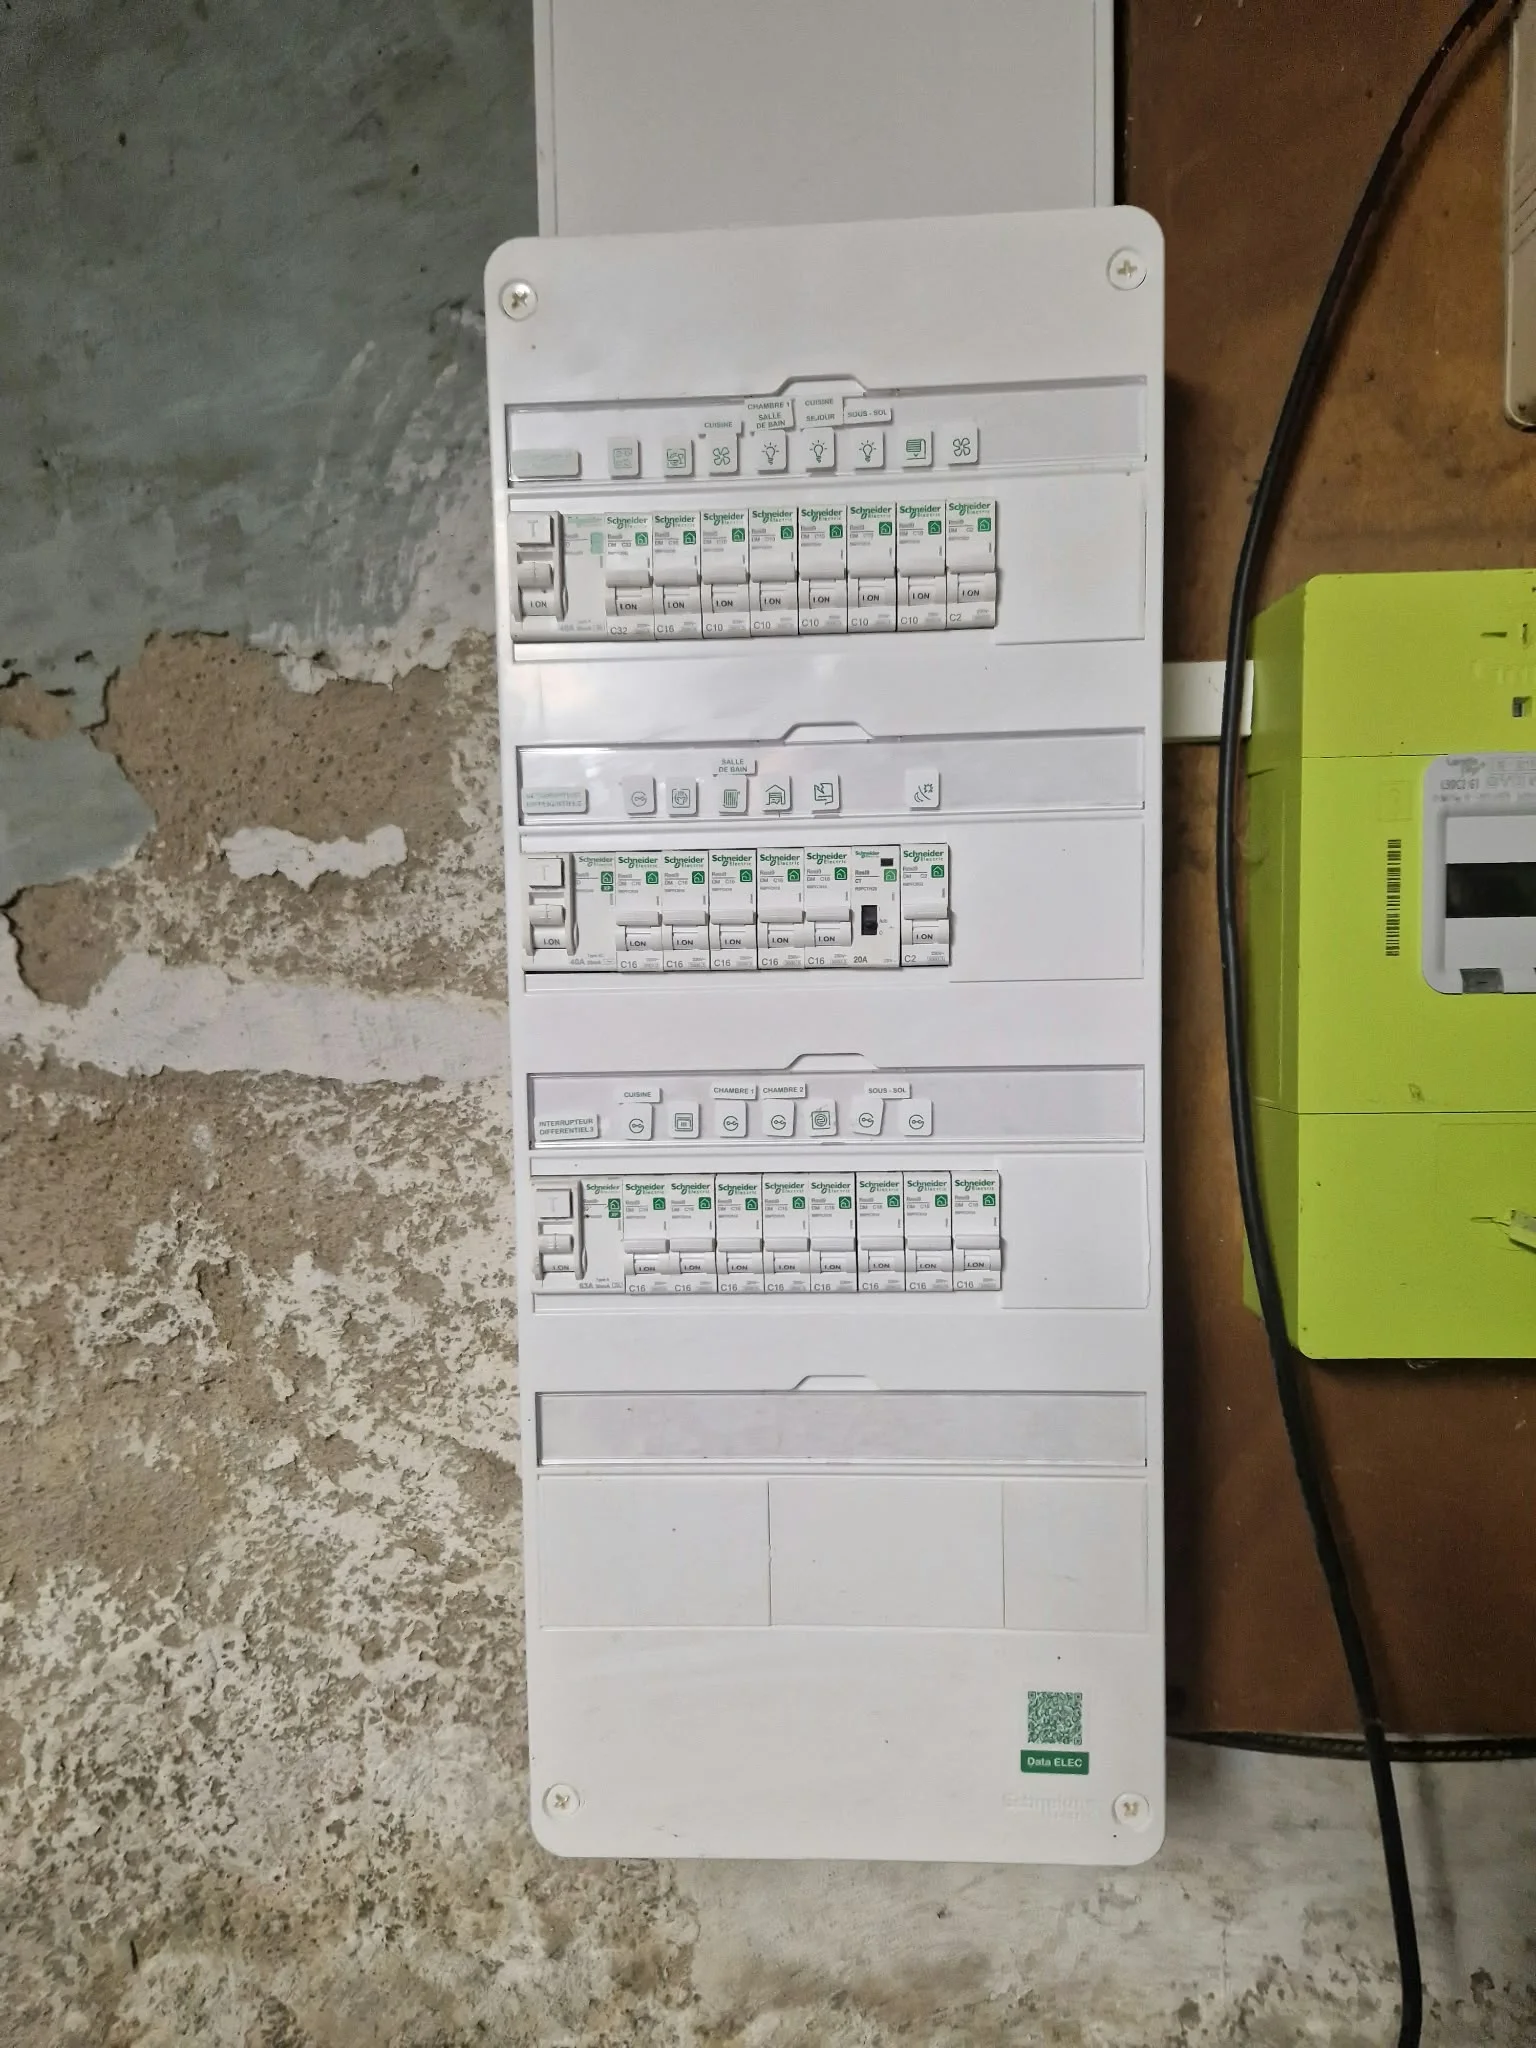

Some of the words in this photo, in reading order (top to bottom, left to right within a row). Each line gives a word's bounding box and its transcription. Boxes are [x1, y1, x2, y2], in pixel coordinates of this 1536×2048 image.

[850, 507, 892, 519] Schneider
[900, 506, 941, 518] Schneider
[949, 503, 991, 515] Schneider
[704, 513, 744, 526] Schneider
[752, 511, 793, 522] Schneider
[801, 509, 842, 522] Schneider
[607, 517, 648, 529] Schneider
[655, 516, 695, 528] Schneider
[802, 619, 819, 627] C10
[851, 618, 868, 626] C10
[901, 617, 918, 625] C10
[950, 614, 961, 622] C2
[611, 627, 627, 635] C32
[657, 625, 674, 633] C16
[706, 624, 723, 632] C10
[712, 855, 752, 866] Schneider
[760, 854, 800, 866] Schneider
[807, 853, 847, 864] Schneider
[904, 850, 944, 862] Schneider
[618, 857, 657, 868] Schneider
[665, 857, 704, 868] Schneider
[621, 961, 637, 969] C16
[667, 960, 683, 968] C16
[714, 959, 730, 967] C16
[762, 958, 778, 966] C16
[808, 957, 824, 965] C16
[539, 1119, 593, 1127] INTERRUPTEUR
[539, 1127, 588, 1135] DIFFERENTIEL
[587, 1184, 620, 1194] Schneider
[626, 1184, 665, 1195] Schneider
[672, 1183, 710, 1195] Schneider
[718, 1184, 757, 1195] Schneider
[765, 1183, 804, 1194] Schneider
[811, 1183, 850, 1194] Schneider
[860, 1181, 899, 1192] Schneider
[907, 1181, 947, 1191] Schneider
[955, 1180, 995, 1191] Schneider
[675, 1284, 691, 1292] C16
[768, 1283, 784, 1291] C16
[814, 1283, 831, 1291] C16
[863, 1282, 879, 1290] C16
[910, 1282, 926, 1290] C16
[957, 1281, 973, 1289] C16
[1027, 1757, 1051, 1767] Data
[1054, 1758, 1082, 1767] ELEC
